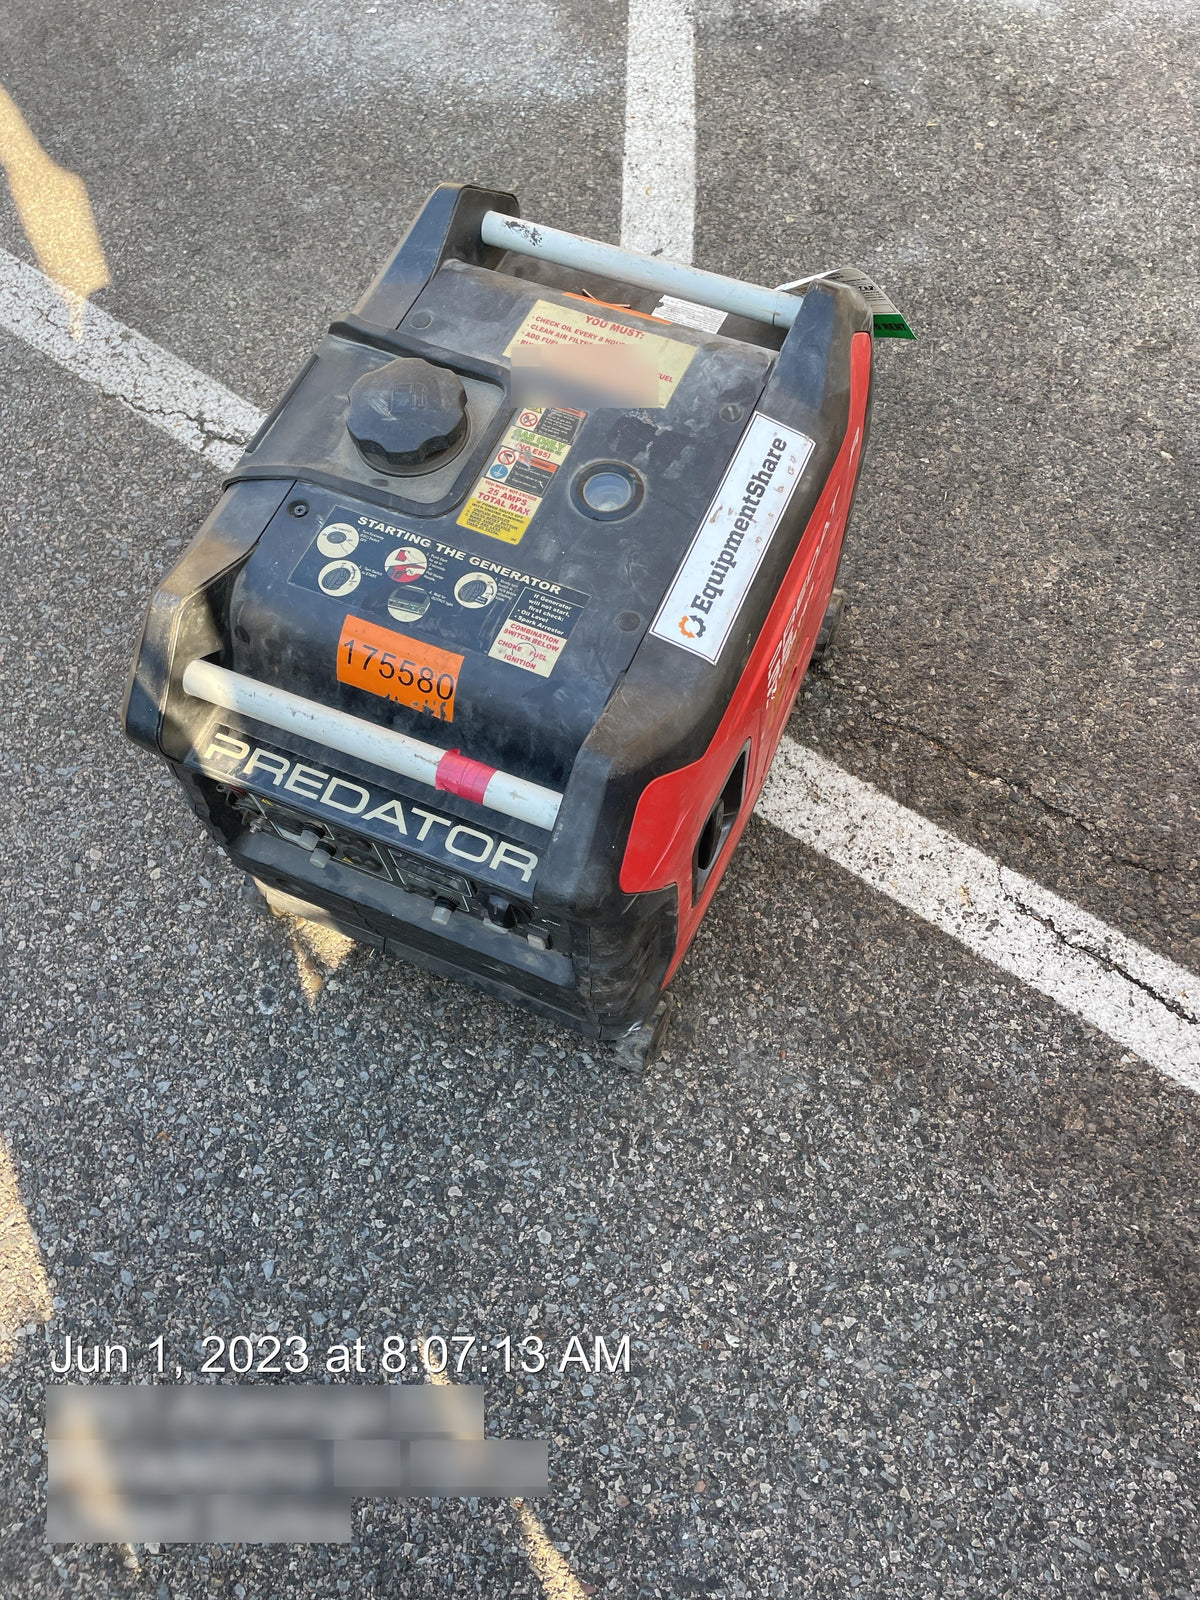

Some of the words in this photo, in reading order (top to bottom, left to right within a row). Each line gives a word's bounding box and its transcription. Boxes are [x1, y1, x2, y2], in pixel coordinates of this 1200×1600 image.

[525, 332, 540, 341] ADD
[530, 324, 554, 335] CLEAN
[555, 331, 568, 340] AIR
[569, 336, 594, 345] FILT
[535, 316, 561, 328] CHECK
[561, 324, 573, 332] OIL
[574, 328, 598, 340] EVERY
[604, 337, 626, 345] HOU
[585, 315, 607, 329] YOU
[609, 323, 645, 339] MUST:
[532, 448, 551, 460] E85)
[477, 491, 506, 508] TOTAL
[508, 503, 531, 516] MAX
[487, 487, 500, 496] 25
[500, 492, 528, 507] AMPS
[691, 436, 787, 615] EquipmentShare
[357, 516, 432, 548] STARTING
[436, 542, 466, 561] THE
[469, 556, 562, 595] GENERATOR
[528, 599, 541, 607] will
[541, 603, 552, 611] not
[528, 605, 542, 614] first
[540, 596, 573, 611] Generator
[517, 615, 536, 626] Spark
[520, 609, 530, 617] Oil
[531, 612, 549, 623] Level
[503, 628, 531, 641] SWITCH
[531, 637, 560, 652] BELOW
[510, 623, 560, 644] COMBINATION
[497, 639, 523, 652] CHOKE
[529, 650, 547, 661] FUEL
[344, 639, 455, 700] 175580
[504, 653, 537, 670] IGNITION
[203, 732, 539, 883] PREDATOR
